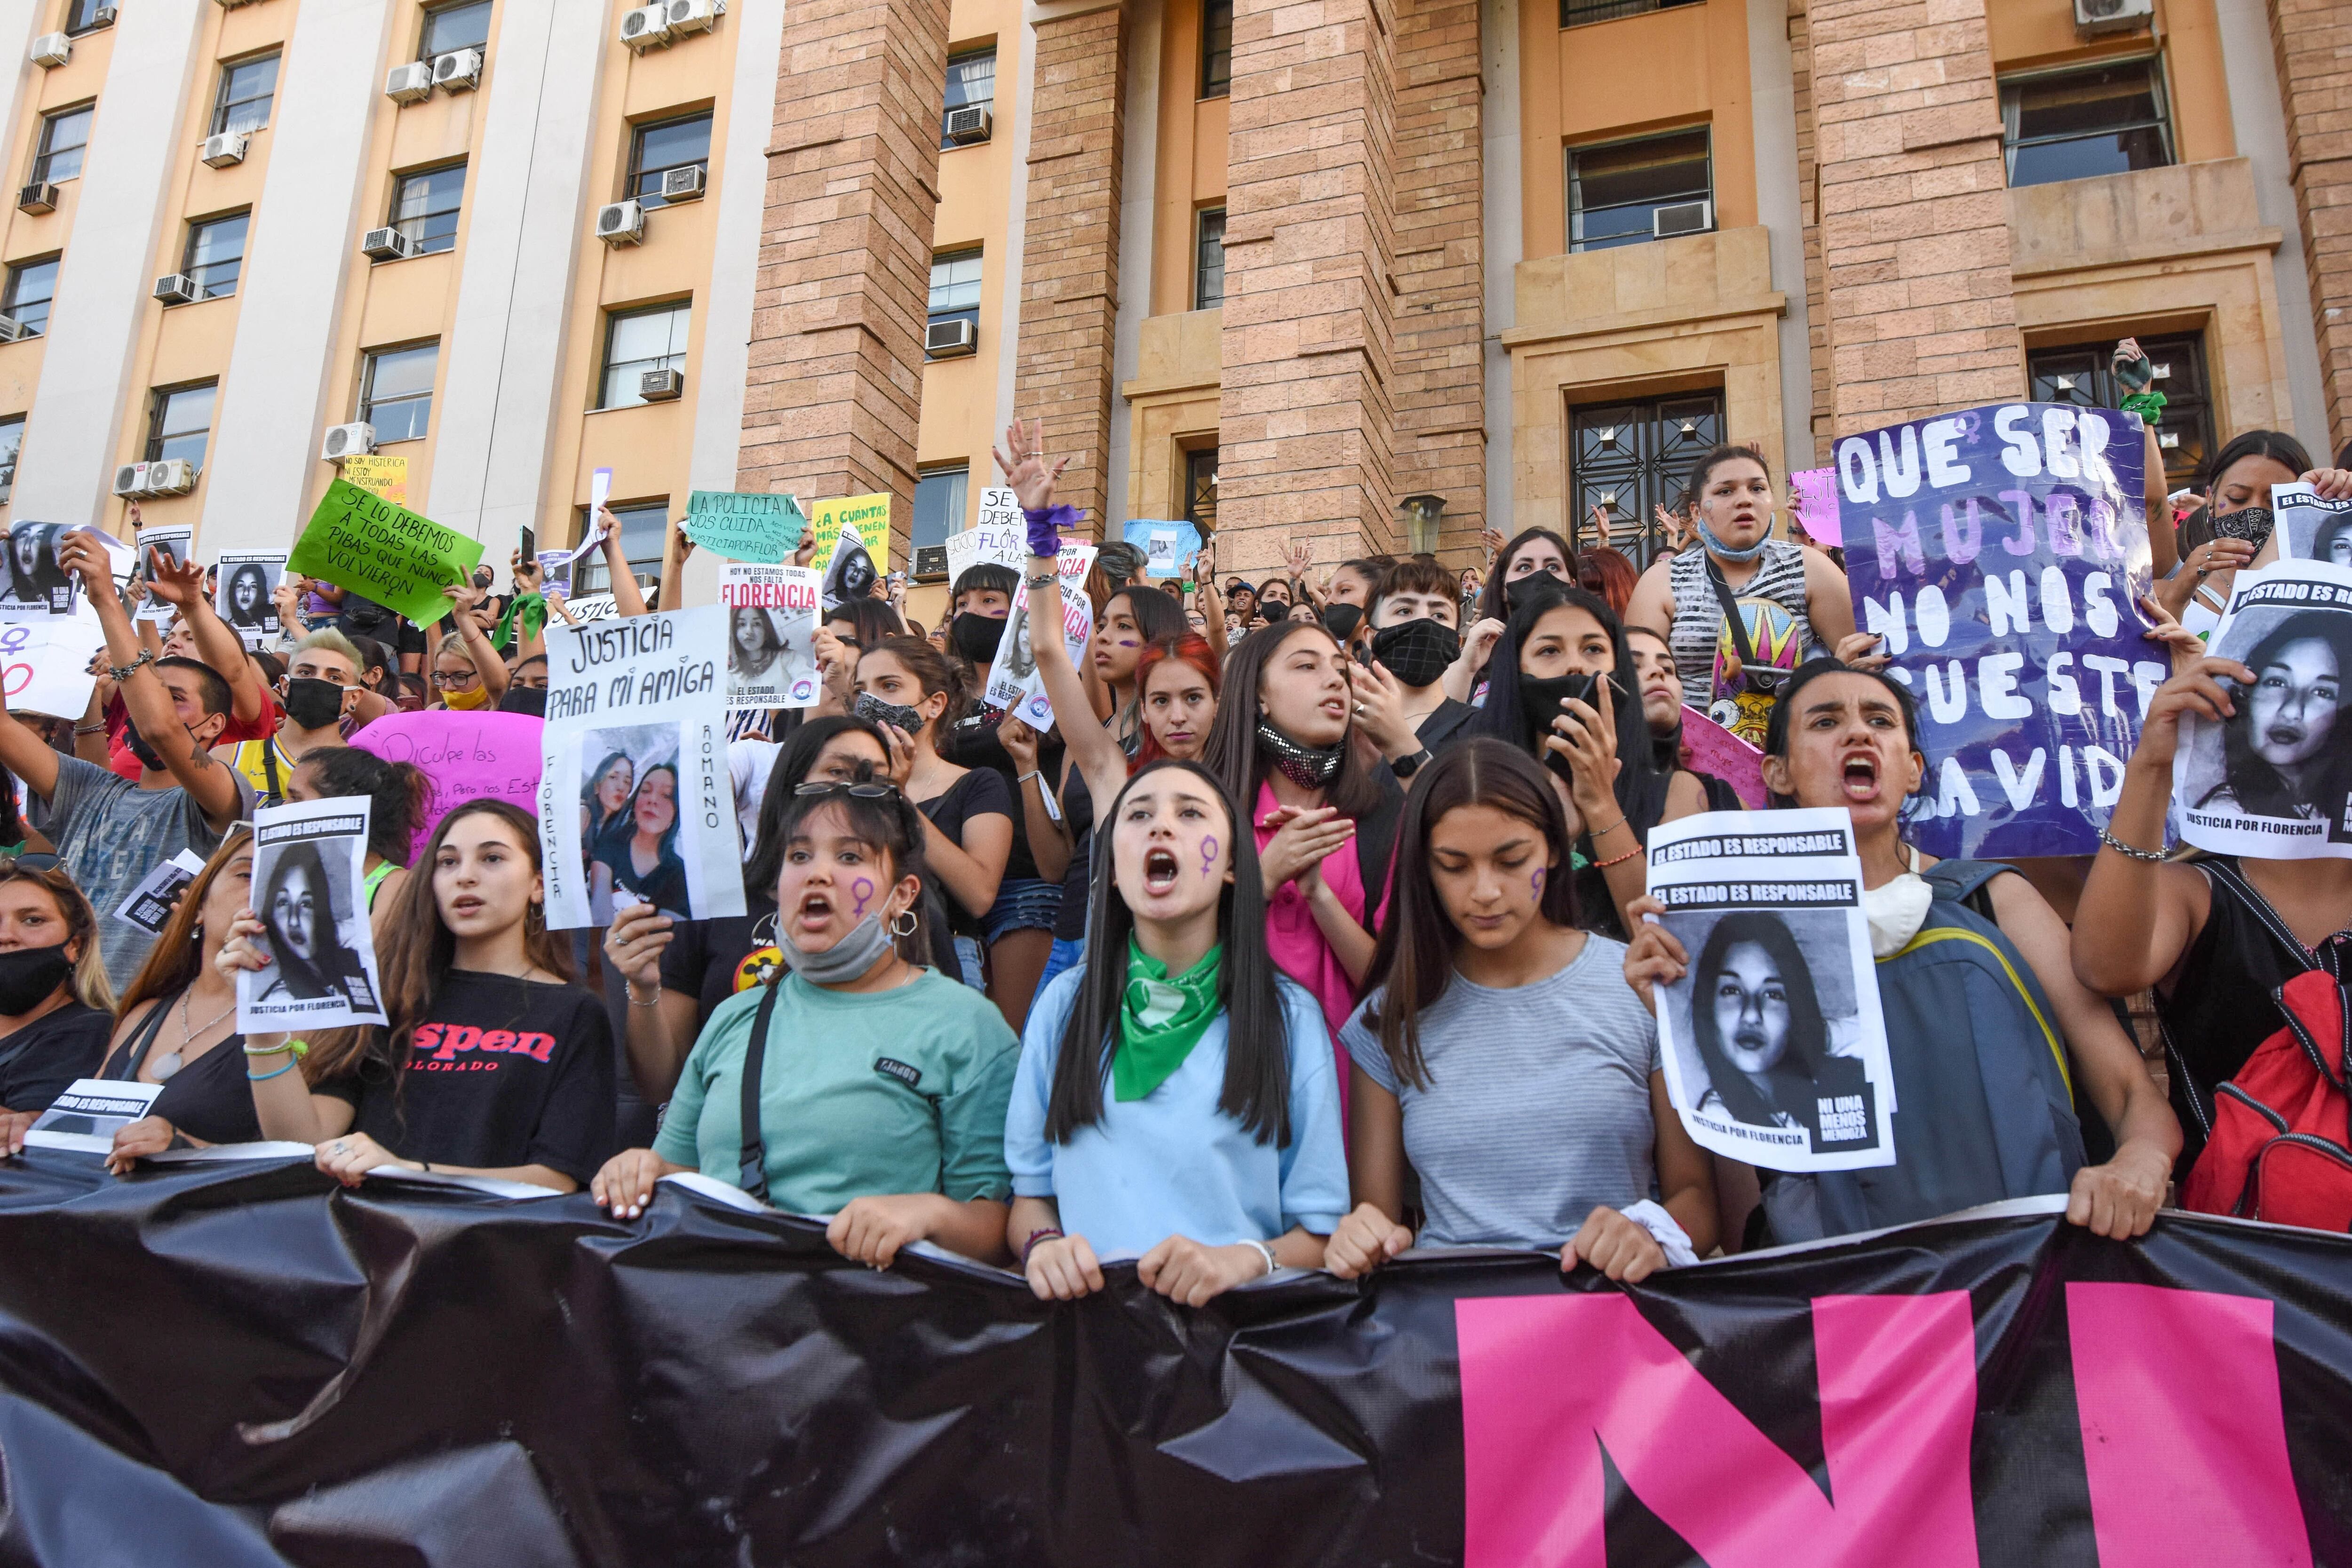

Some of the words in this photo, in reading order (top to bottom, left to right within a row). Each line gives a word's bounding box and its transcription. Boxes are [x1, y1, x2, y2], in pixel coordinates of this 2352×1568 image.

[1839, 418, 1971, 504] QUE
[1993, 404, 2115, 485] SER
[349, 477, 392, 486] MENSTRUANDO
[353, 467, 371, 476] ESTOY
[691, 496, 707, 514] LA
[714, 495, 781, 515] POLICIA
[985, 491, 1012, 507] SE
[2282, 497, 2294, 506] EL
[2296, 494, 2334, 509] ESTADO
[2335, 501, 2348, 510] ES
[342, 488, 368, 511] SE
[370, 501, 389, 522] LO
[392, 512, 456, 553] DEBEMOS
[840, 505, 886, 523] CUÁNTAS
[340, 511, 351, 526] A
[359, 517, 405, 550] TODAS
[410, 545, 437, 565] LAS
[978, 533, 1019, 550] FLOR
[1001, 528, 1010, 538] A
[1872, 489, 2126, 580] MUJER
[329, 526, 370, 555] PIBAS
[377, 549, 404, 568] QUE
[408, 563, 453, 588] NUNCA
[992, 550, 1004, 562] A
[730, 567, 741, 576] HOY
[786, 569, 805, 578] TODAS
[722, 583, 816, 609] FLORENCIA
[1073, 593, 1086, 611] POR
[2249, 583, 2309, 600] ESTADO
[2310, 585, 2333, 601] ES
[1863, 584, 1950, 655] NO
[1984, 565, 2119, 638] NOS
[748, 686, 775, 695] ESTADO
[990, 686, 997, 696] ES
[1000, 681, 1008, 691] EL
[548, 682, 597, 721] PARA
[736, 695, 785, 705] RESPONSABLE
[473, 730, 496, 762] las
[453, 783, 477, 795] Pero
[507, 777, 540, 794] Est
[701, 725, 719, 828] ROMANO
[1990, 745, 2129, 812] VID
[292, 823, 302, 836] ES
[302, 817, 362, 834] RESPONSABLE
[542, 755, 561, 899] FLORENCIA
[2186, 812, 2232, 829] JUSTICIA
[2235, 820, 2258, 831] POR
[2262, 822, 2322, 835] FLORENCIA
[1654, 850, 1668, 866] EL
[1667, 839, 1720, 862] ESTADO
[1724, 838, 1741, 854] ES
[1742, 834, 1843, 855] RESPONSABLE
[1653, 889, 1669, 906] EL
[1671, 884, 1728, 904] ESTADO
[1730, 884, 1749, 902] ES
[1750, 883, 1853, 902] RESPONSABLE
[251, 1006, 286, 1014] JUSTICIA
[308, 1000, 346, 1010] FLORENCIA
[414, 1022, 556, 1063] spen
[77, 1098, 91, 1109] ES
[89, 1098, 145, 1113] RESPONSABLE
[1818, 1098, 1834, 1114] NI
[1835, 1094, 1864, 1113] UNA
[1692, 1114, 1728, 1134] JUSTICIA
[1730, 1126, 1748, 1138] POR
[1750, 1130, 1803, 1145] FLORENCIA
[1819, 1110, 1867, 1130] MENOS
[1821, 1126, 1867, 1142] MENDOZA
[1454, 1281, 2314, 1568] NI
